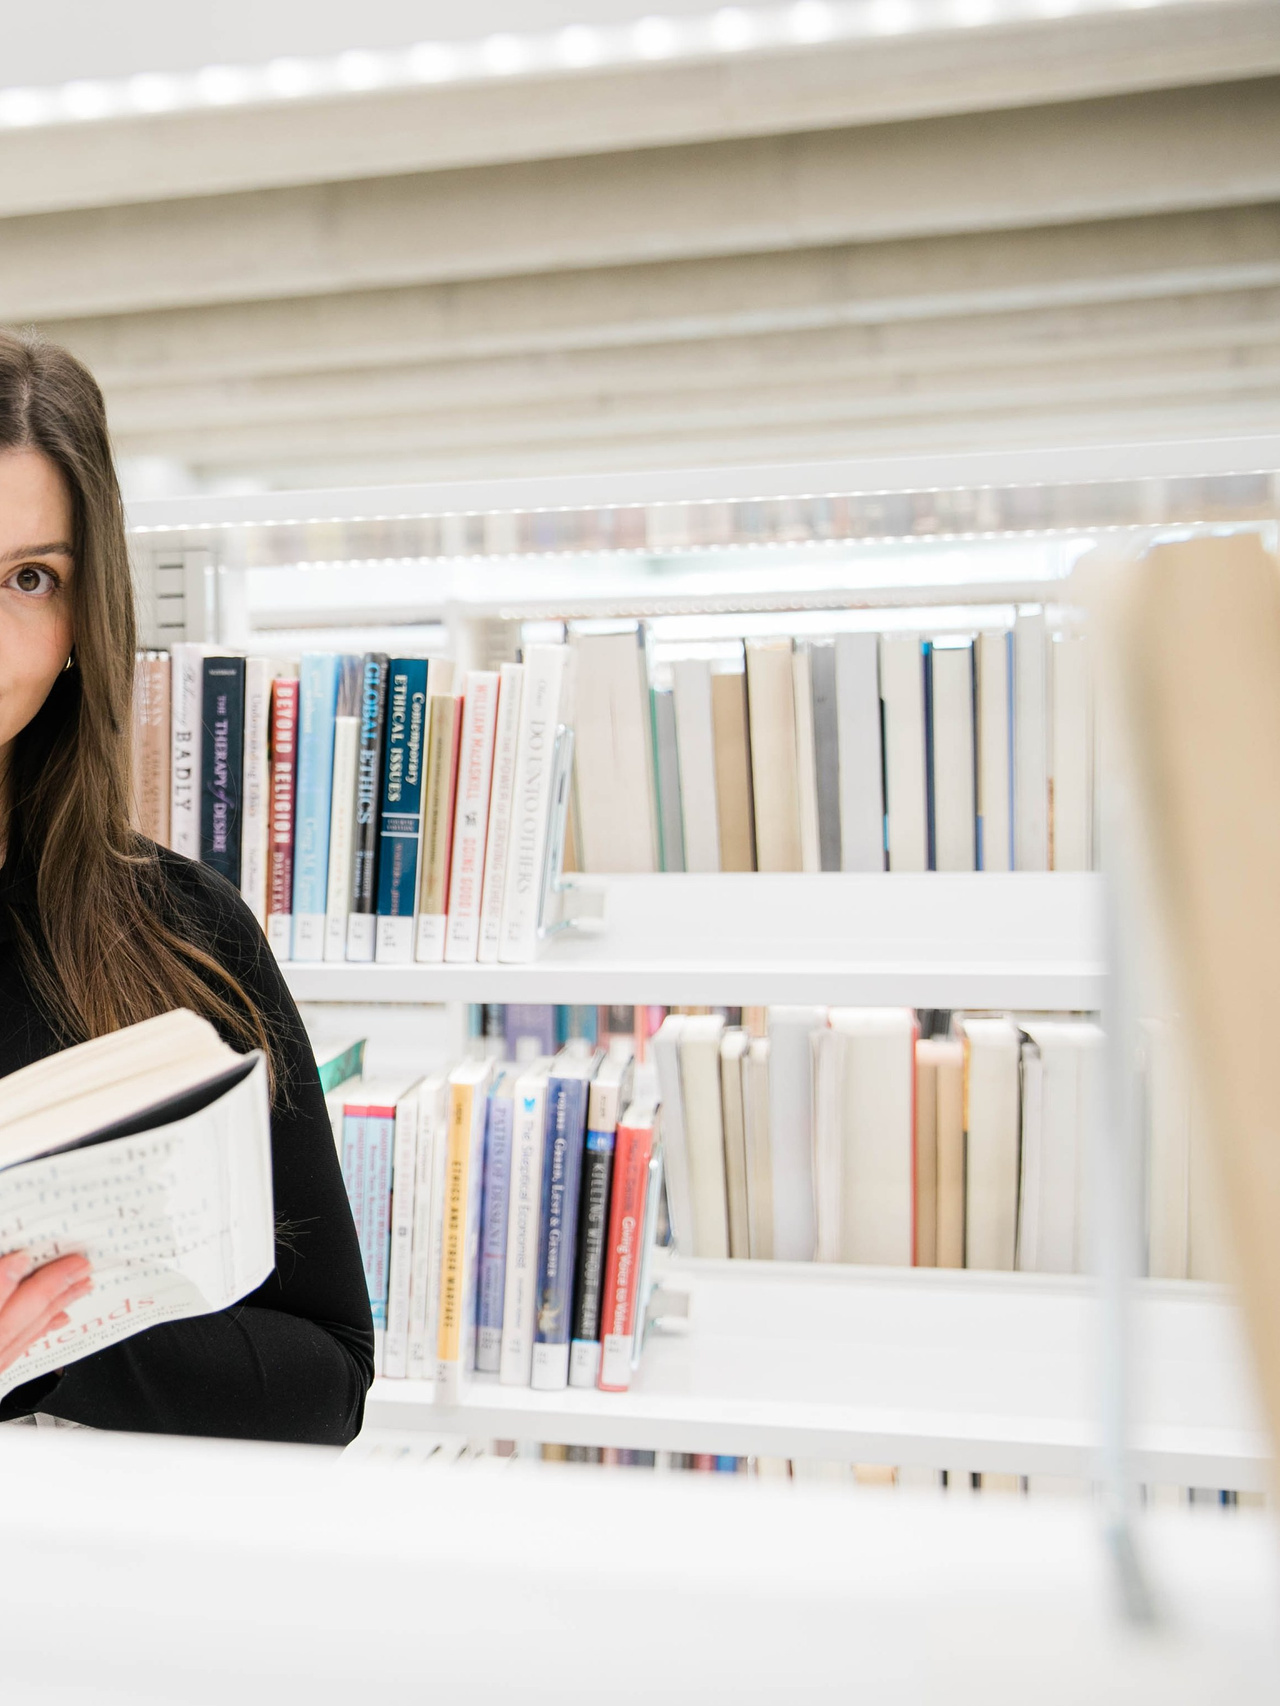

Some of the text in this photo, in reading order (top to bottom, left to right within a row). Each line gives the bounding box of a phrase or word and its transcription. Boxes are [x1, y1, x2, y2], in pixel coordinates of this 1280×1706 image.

[217, 696, 227, 716] THE
[213, 721, 229, 788] THERAPY
[356, 662, 380, 824] GLOBAL ETHICS
[387, 673, 408, 802] ETHICAL ISSUES
[405, 691, 425, 787] Contemporary
[528, 720, 547, 751] DO
[175, 731, 192, 813] BADLY
[273, 687, 294, 844] BEYOND RELIGION
[522, 756, 544, 813] UNTO
[212, 802, 227, 852] DESIRE
[516, 817, 538, 896] OTHERS
[522, 1121, 533, 1141] The
[450, 1161, 462, 1203] ETHICS
[516, 1145, 532, 1201] Skeptical
[449, 1208, 460, 1230] AND
[515, 1206, 529, 1269] Economist
[617, 1216, 636, 1254] Giving
[447, 1234, 458, 1272] CYBER
[582, 1162, 606, 1338] KILLING WITHOUT HEART
[617, 1255, 632, 1286] Voice
[443, 1276, 456, 1328] WARFARE
[616, 1288, 628, 1301] to
[24, 1296, 155, 1358] riends
